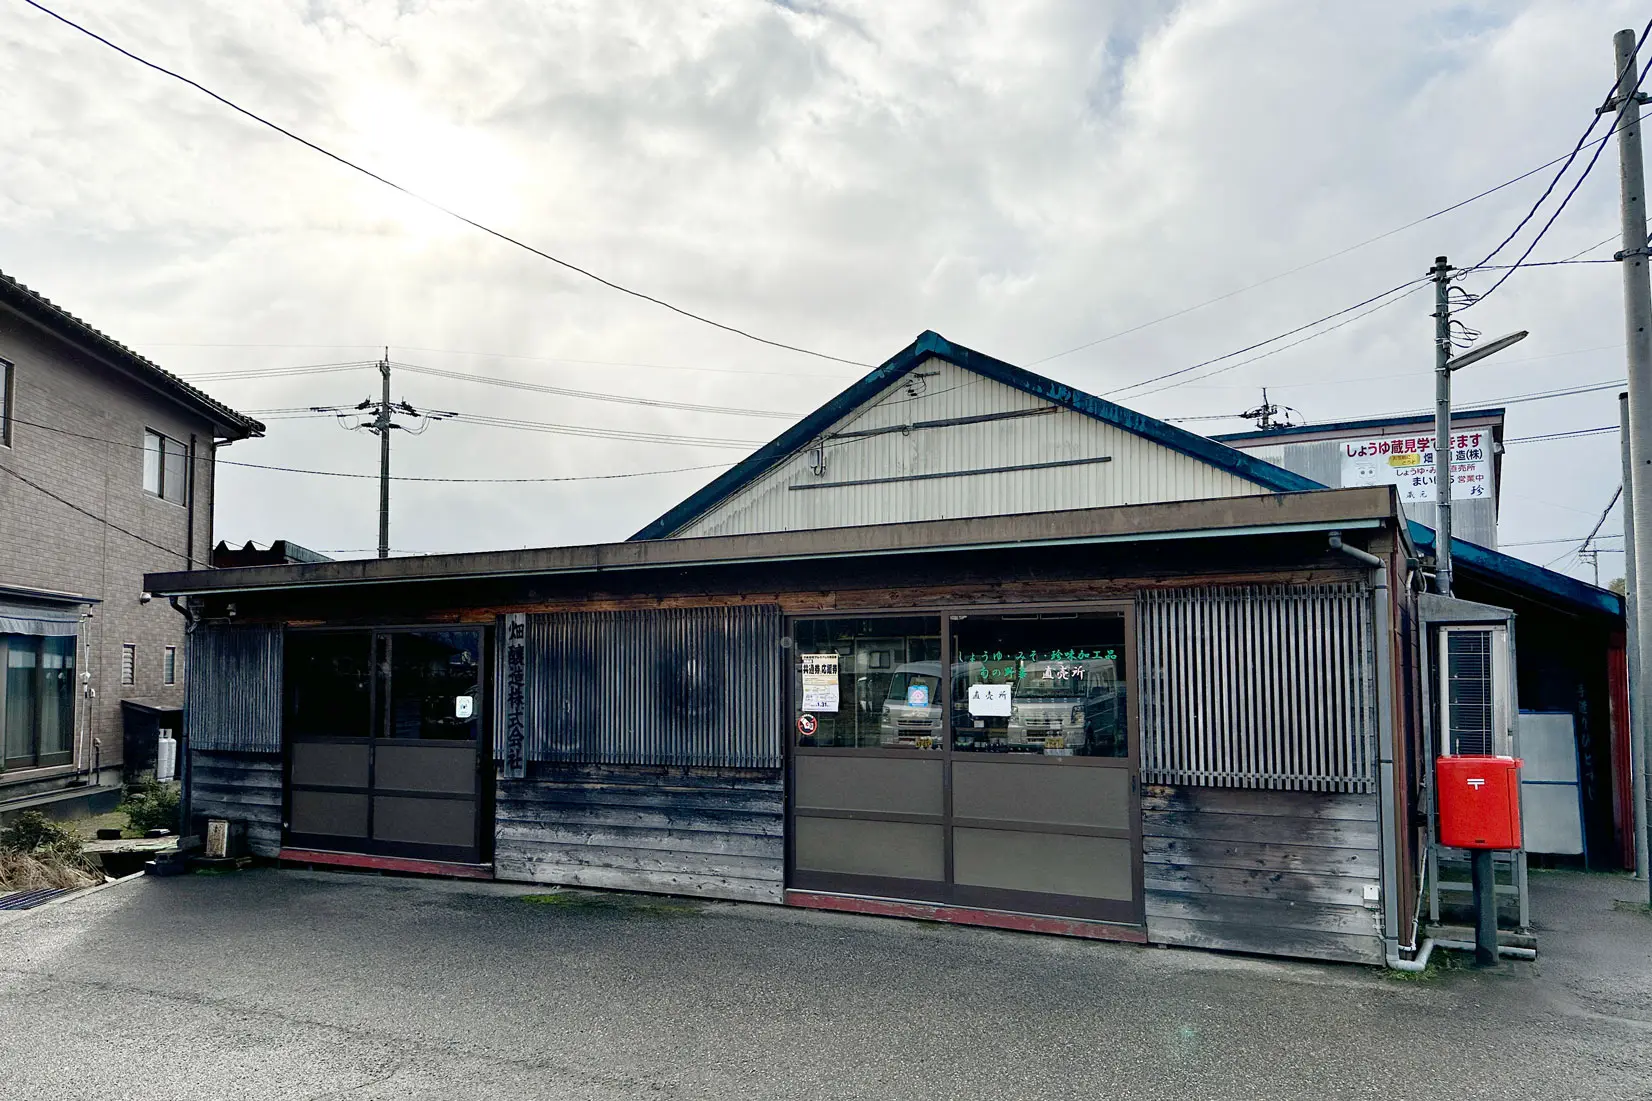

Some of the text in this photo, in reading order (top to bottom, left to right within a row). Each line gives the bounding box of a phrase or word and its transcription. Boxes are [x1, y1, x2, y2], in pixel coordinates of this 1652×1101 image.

[1423, 448, 1483, 463] 畑造(株)
[1396, 463, 1476, 476] しょうゆ・み直売所
[1041, 665, 1086, 681] 直売所
[972, 689, 1008, 701] 直売所
